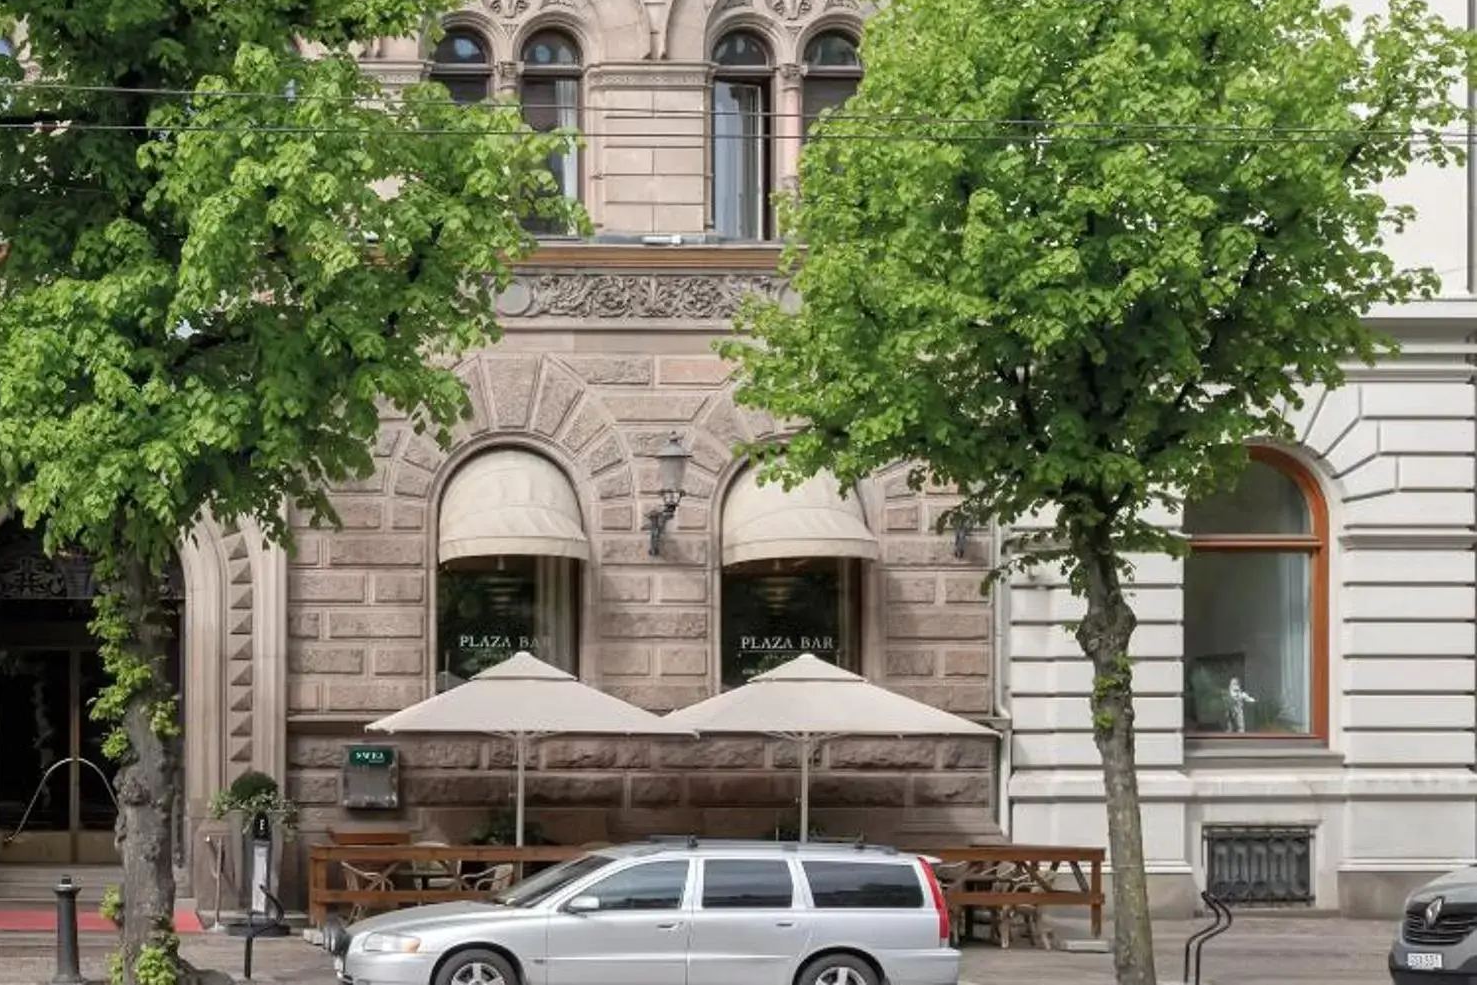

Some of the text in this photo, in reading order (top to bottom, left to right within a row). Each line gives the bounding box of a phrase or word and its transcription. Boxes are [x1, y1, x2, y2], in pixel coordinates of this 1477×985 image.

[460, 635, 511, 648] PLAZA
[741, 636, 833, 649] PLAZA BAR
